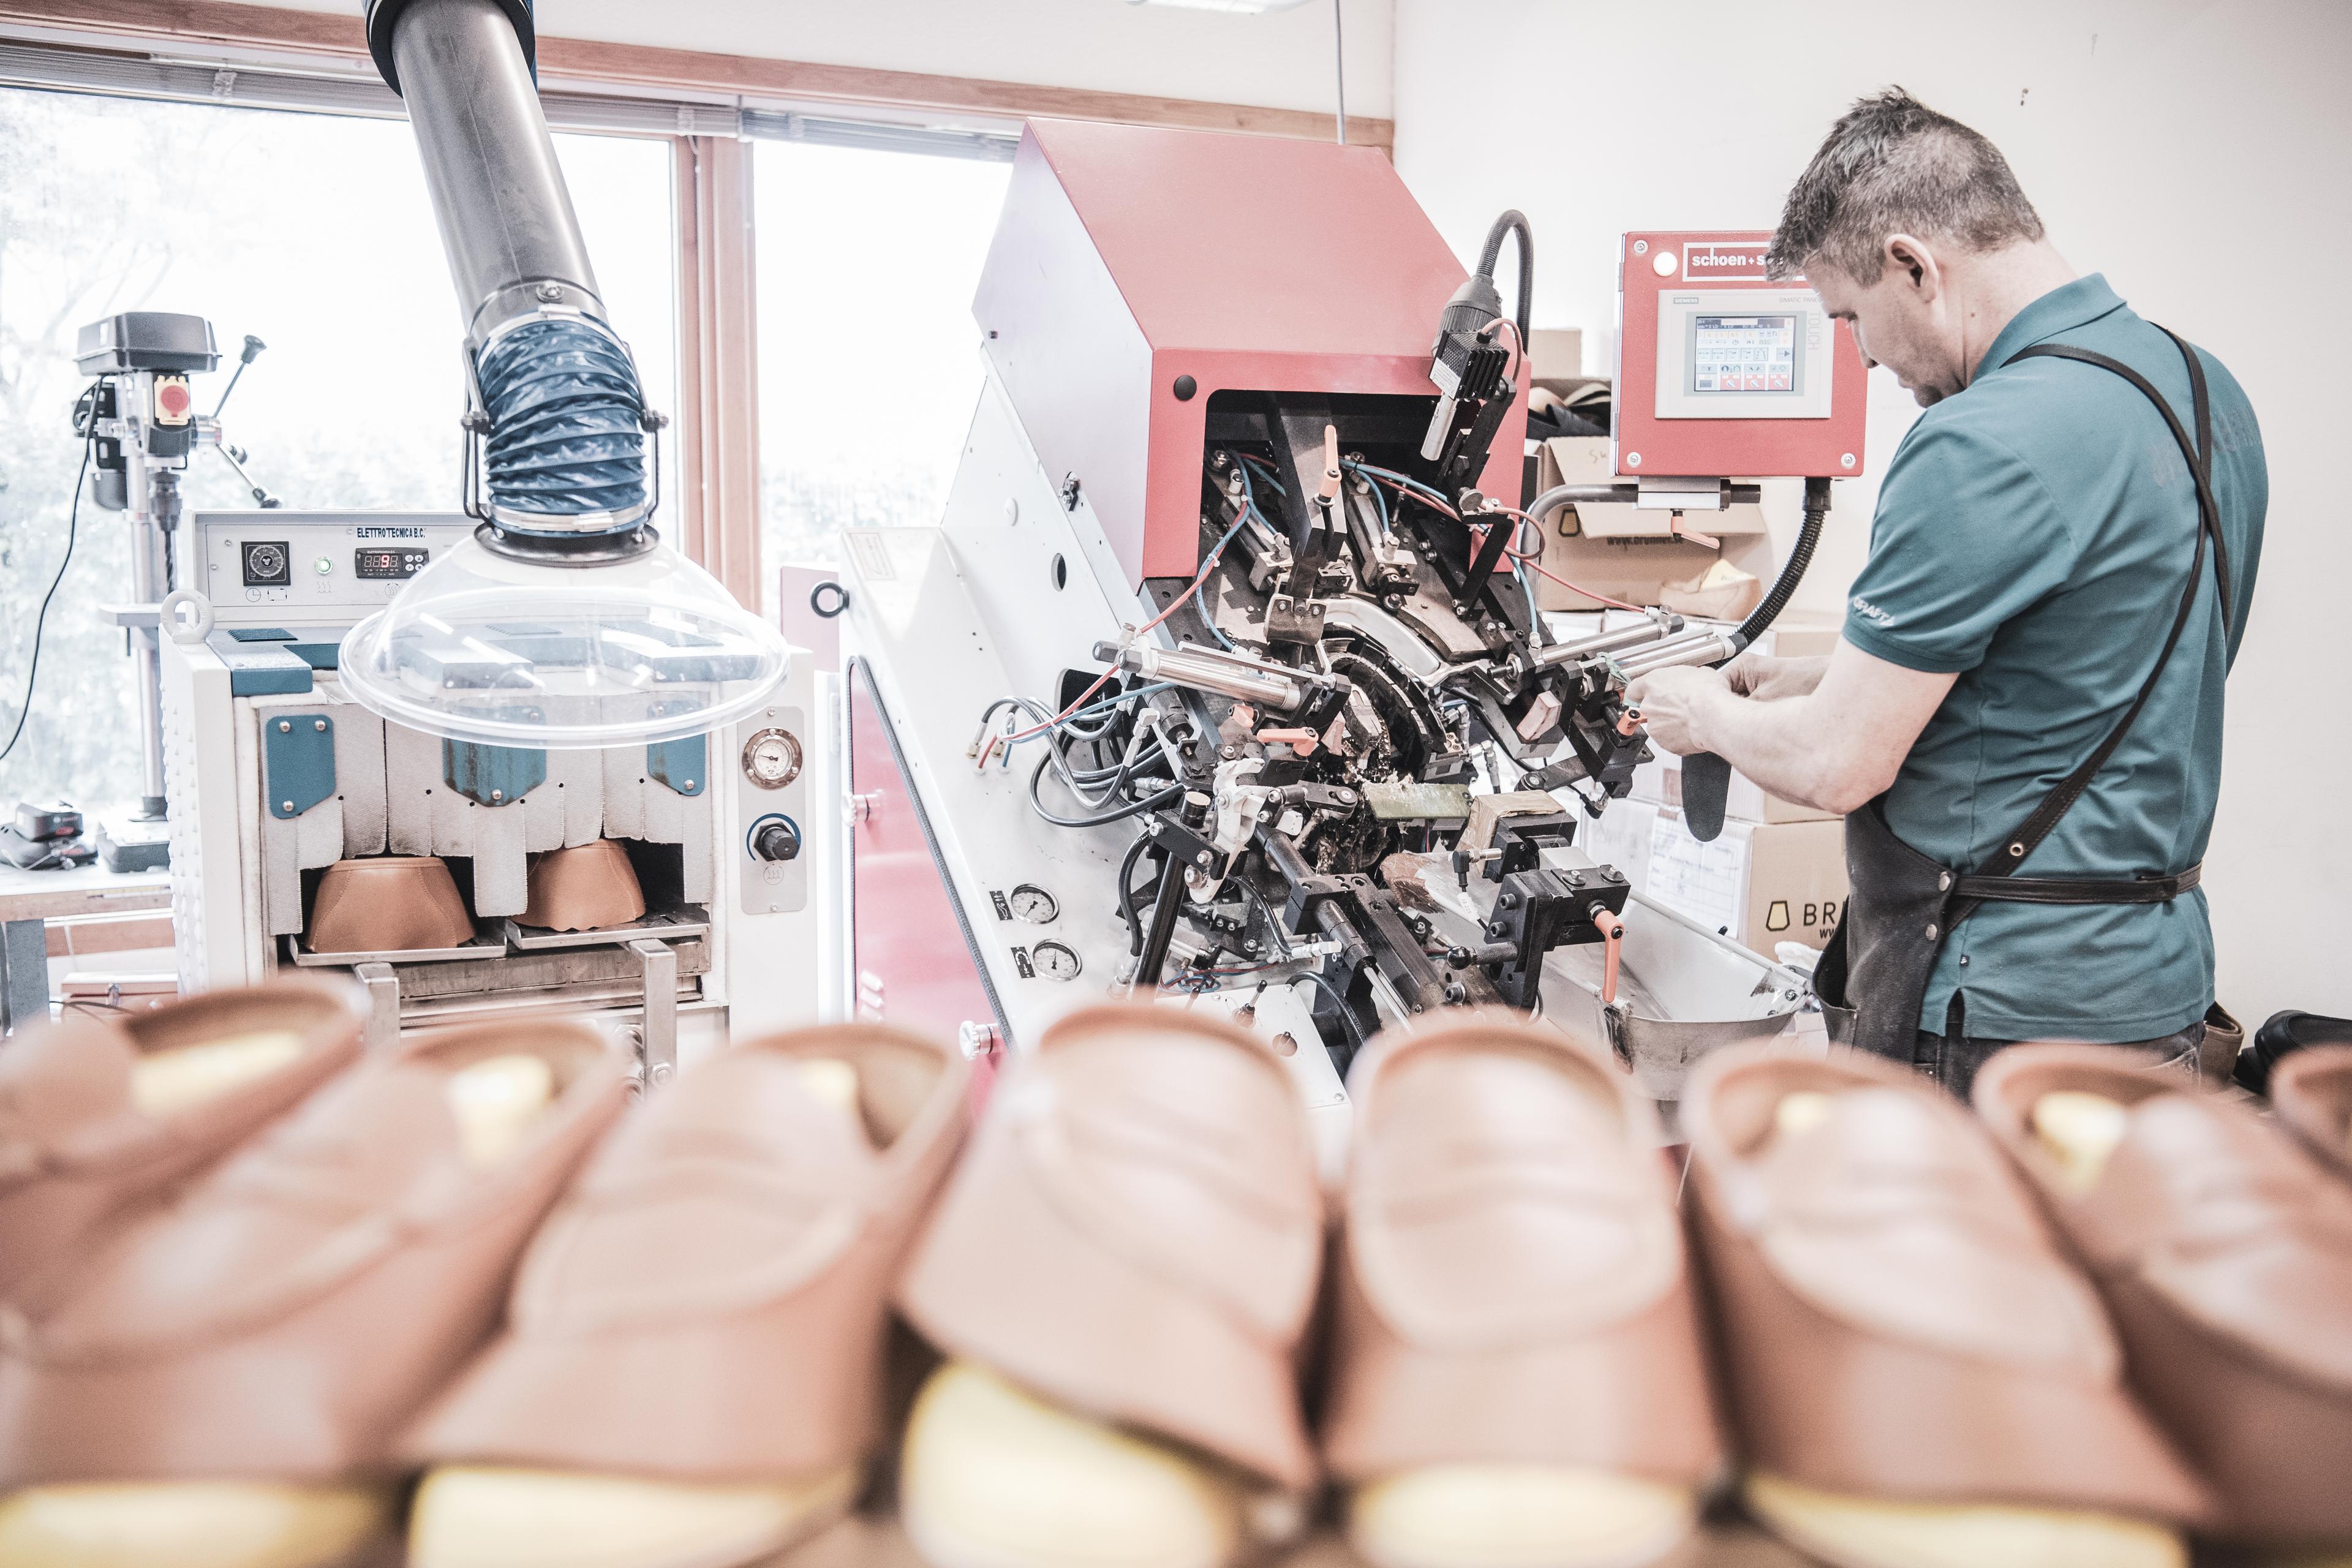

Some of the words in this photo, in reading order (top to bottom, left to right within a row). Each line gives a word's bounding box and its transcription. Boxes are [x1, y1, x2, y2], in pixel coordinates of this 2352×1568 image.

[1692, 247, 1746, 266] schoen
[1807, 310, 1822, 350] TOUCH
[357, 528, 413, 538] ELETTROTECNICA
[414, 528, 425, 538] B.C.
[1853, 596, 1890, 621] CRAFT
[1803, 901, 1845, 927] BR
